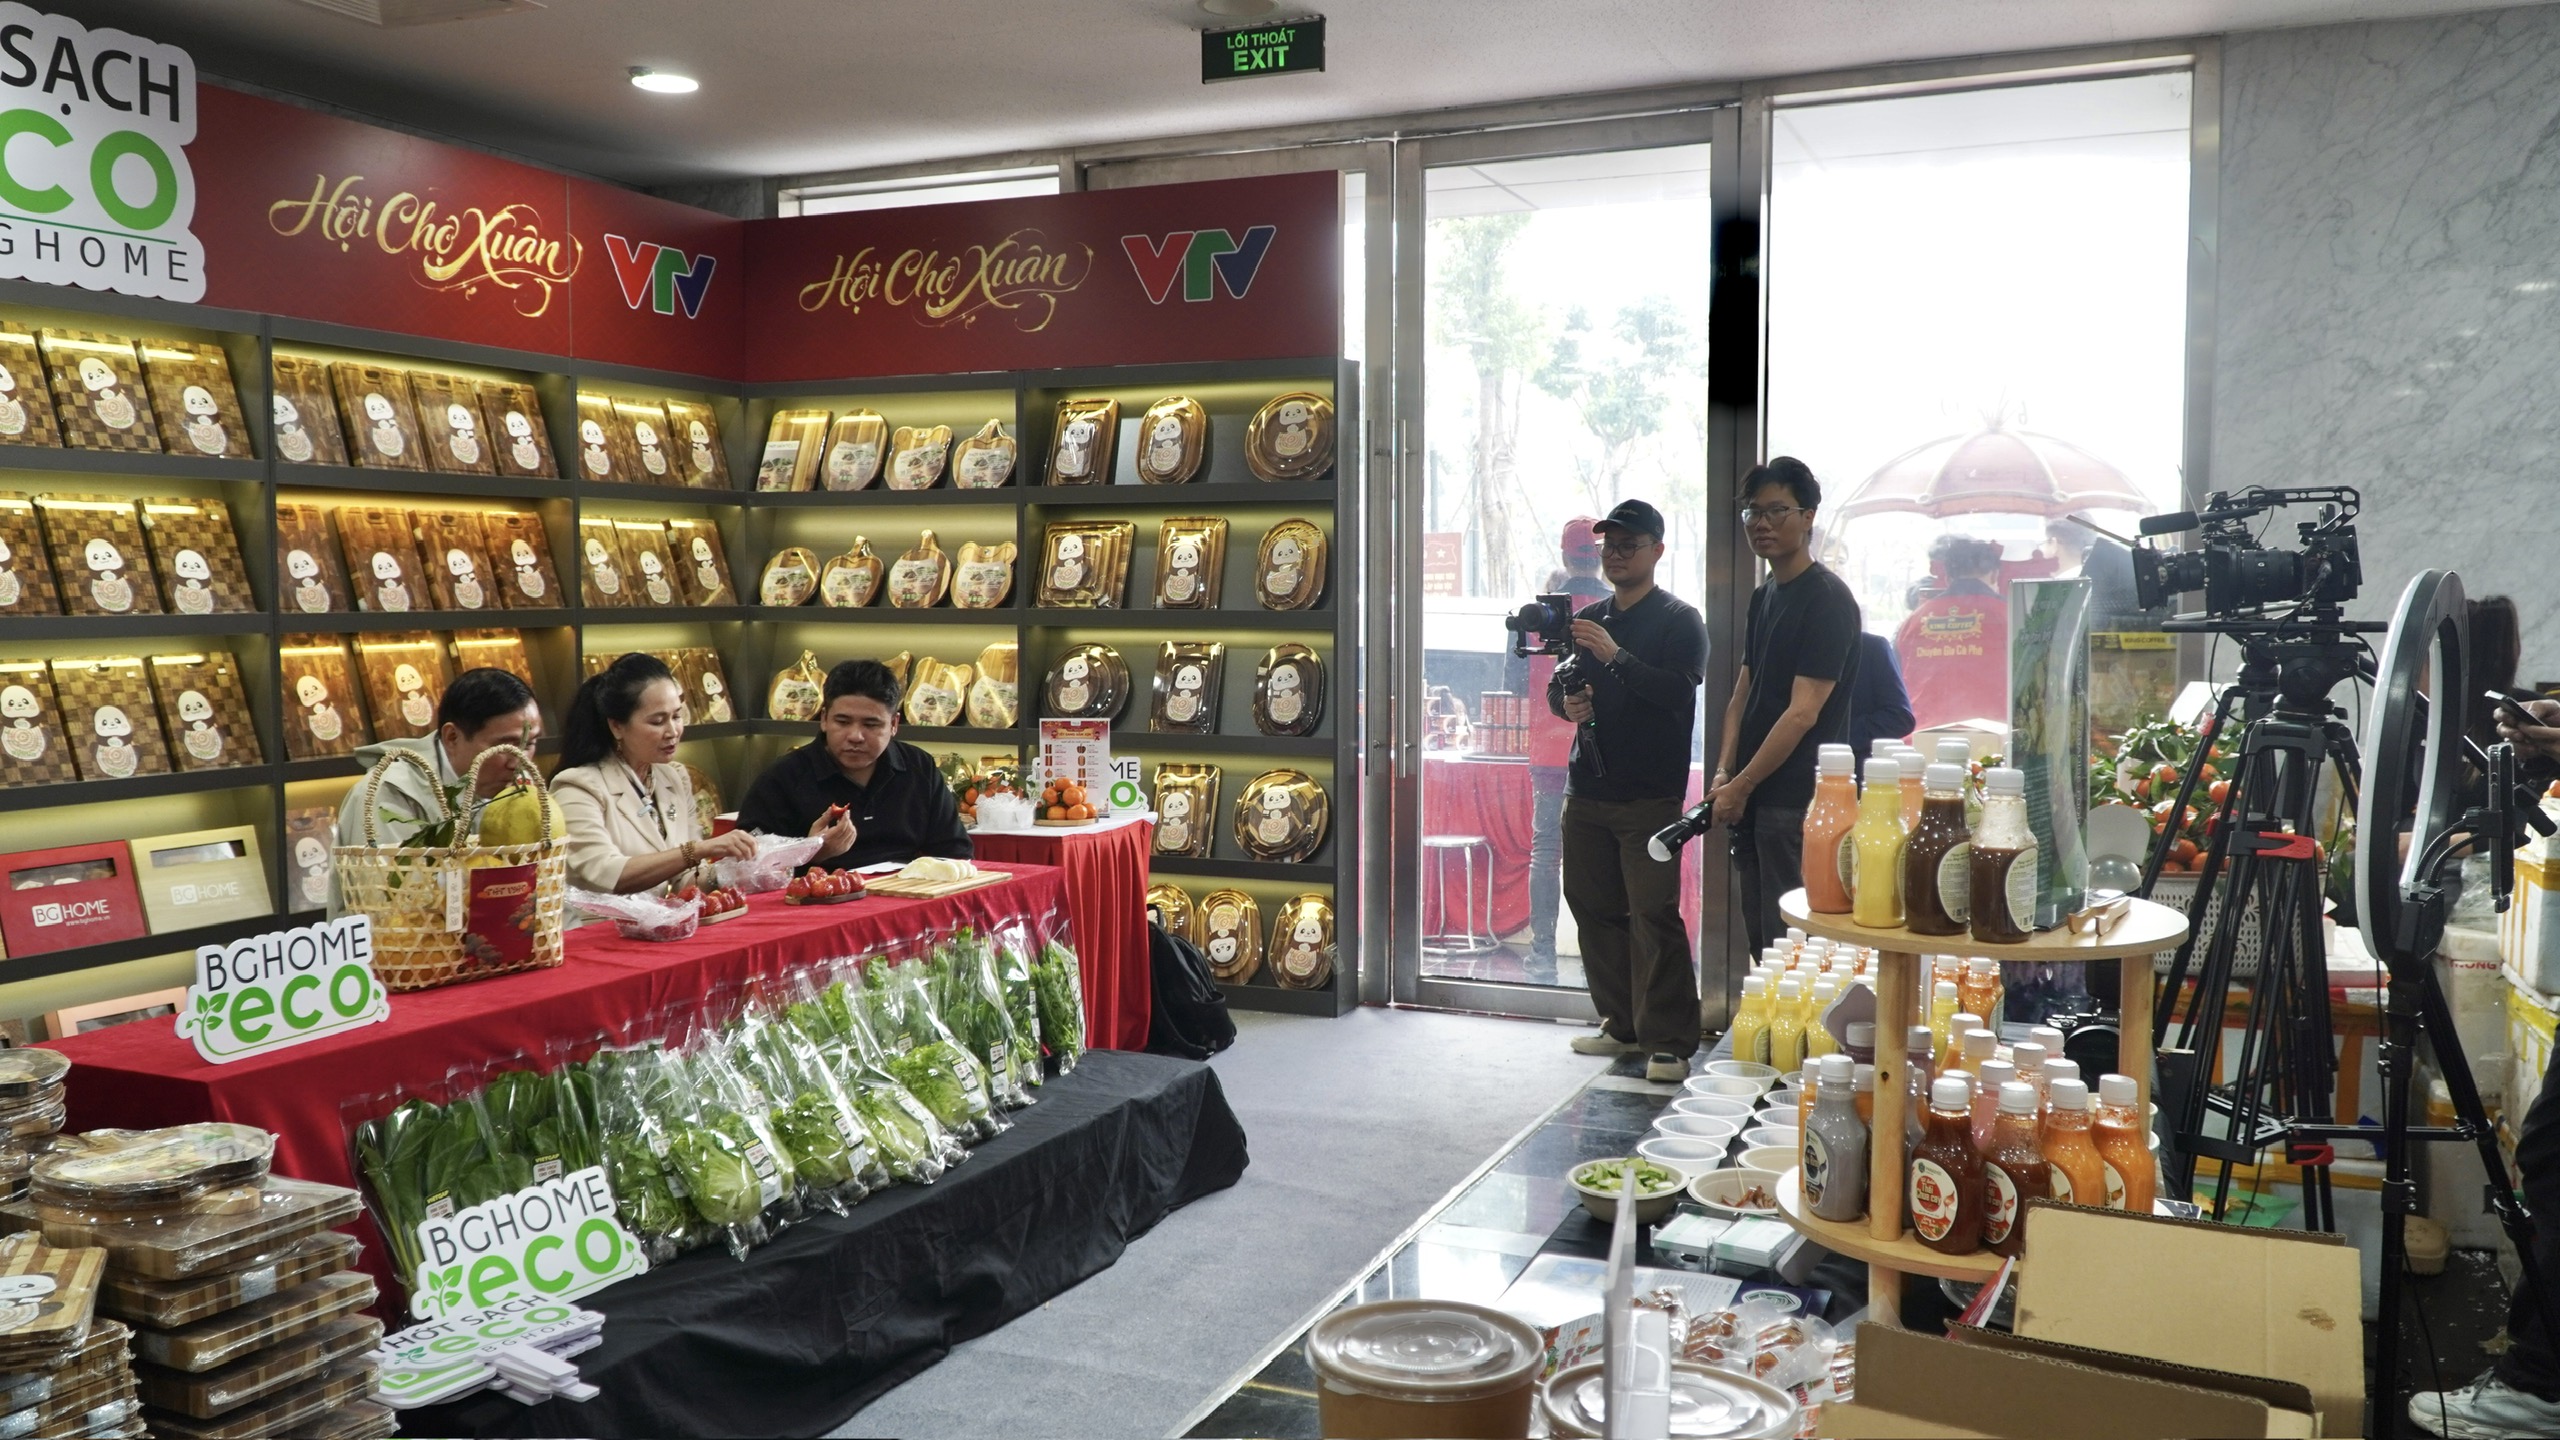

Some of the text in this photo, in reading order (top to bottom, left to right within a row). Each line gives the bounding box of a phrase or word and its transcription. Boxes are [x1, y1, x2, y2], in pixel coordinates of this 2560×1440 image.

[0, 24, 180, 123] SẠCH
[1226, 28, 1296, 49] LỐI THOÁT
[1233, 45, 1290, 71] EXIT
[269, 174, 372, 253] Hội
[376, 190, 459, 269] Chợ
[604, 233, 717, 319] VTV
[800, 246, 881, 315] Hội
[884, 248, 961, 308] Chợ
[1120, 225, 1277, 305] VTV
[205, 923, 368, 991] BGHOME
[229, 963, 371, 1043] eco
[427, 1174, 610, 1266] BGHOME
[468, 1218, 622, 1309] eco
[429, 1307, 571, 1354] eco
[460, 1294, 549, 1326] SẠCH
[481, 1313, 595, 1353] BGHOME
